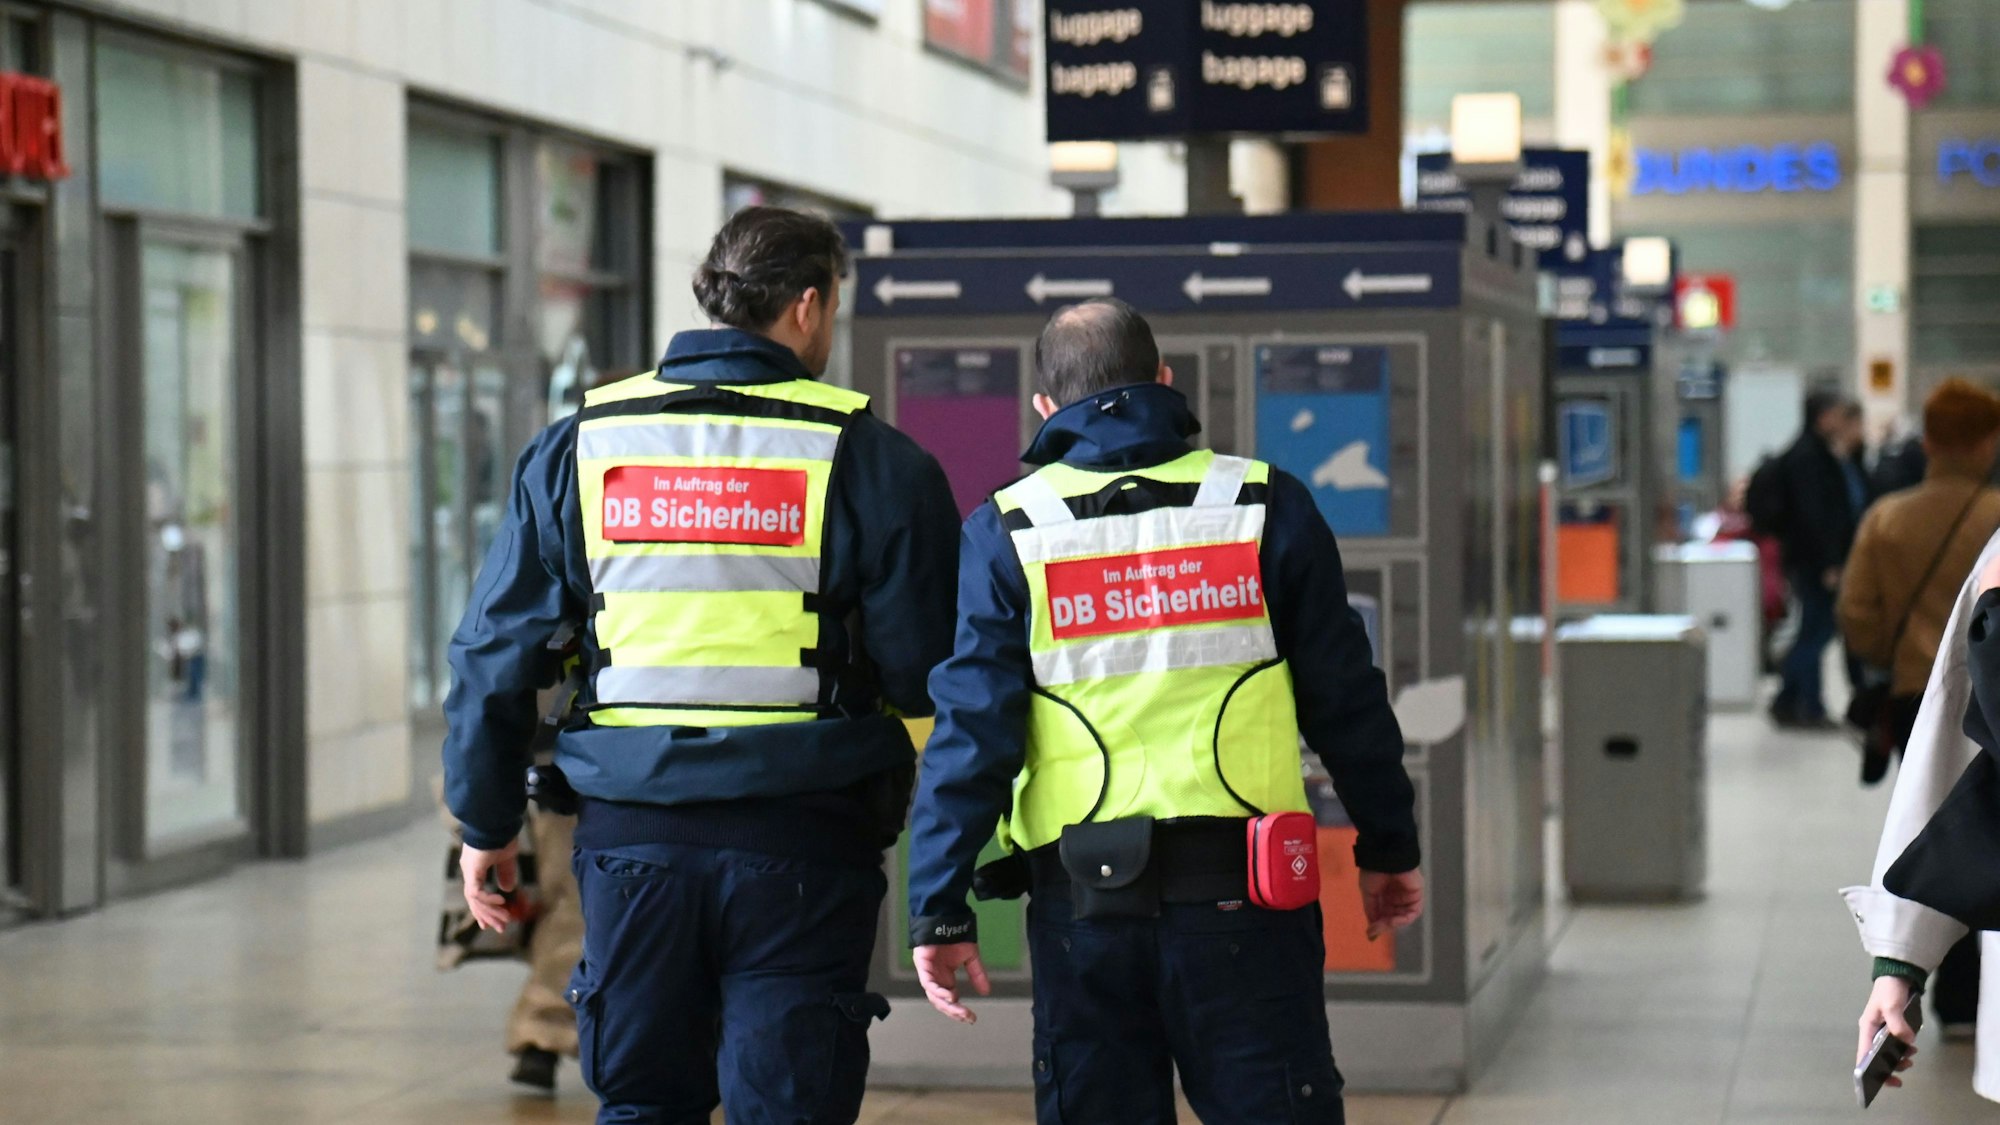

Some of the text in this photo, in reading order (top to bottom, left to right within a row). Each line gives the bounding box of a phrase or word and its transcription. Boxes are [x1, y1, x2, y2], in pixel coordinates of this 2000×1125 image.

[1050, 8, 1143, 46] luggage
[1201, 0, 1314, 37] luggage
[1051, 60, 1137, 98] bagage
[1201, 50, 1307, 90] bagage
[653, 476, 750, 495] Im Auftrag der
[604, 497, 801, 534] DB Sicherheit
[1102, 559, 1203, 584] Im Auftrag der
[1052, 575, 1261, 628] DB Sicherheit
